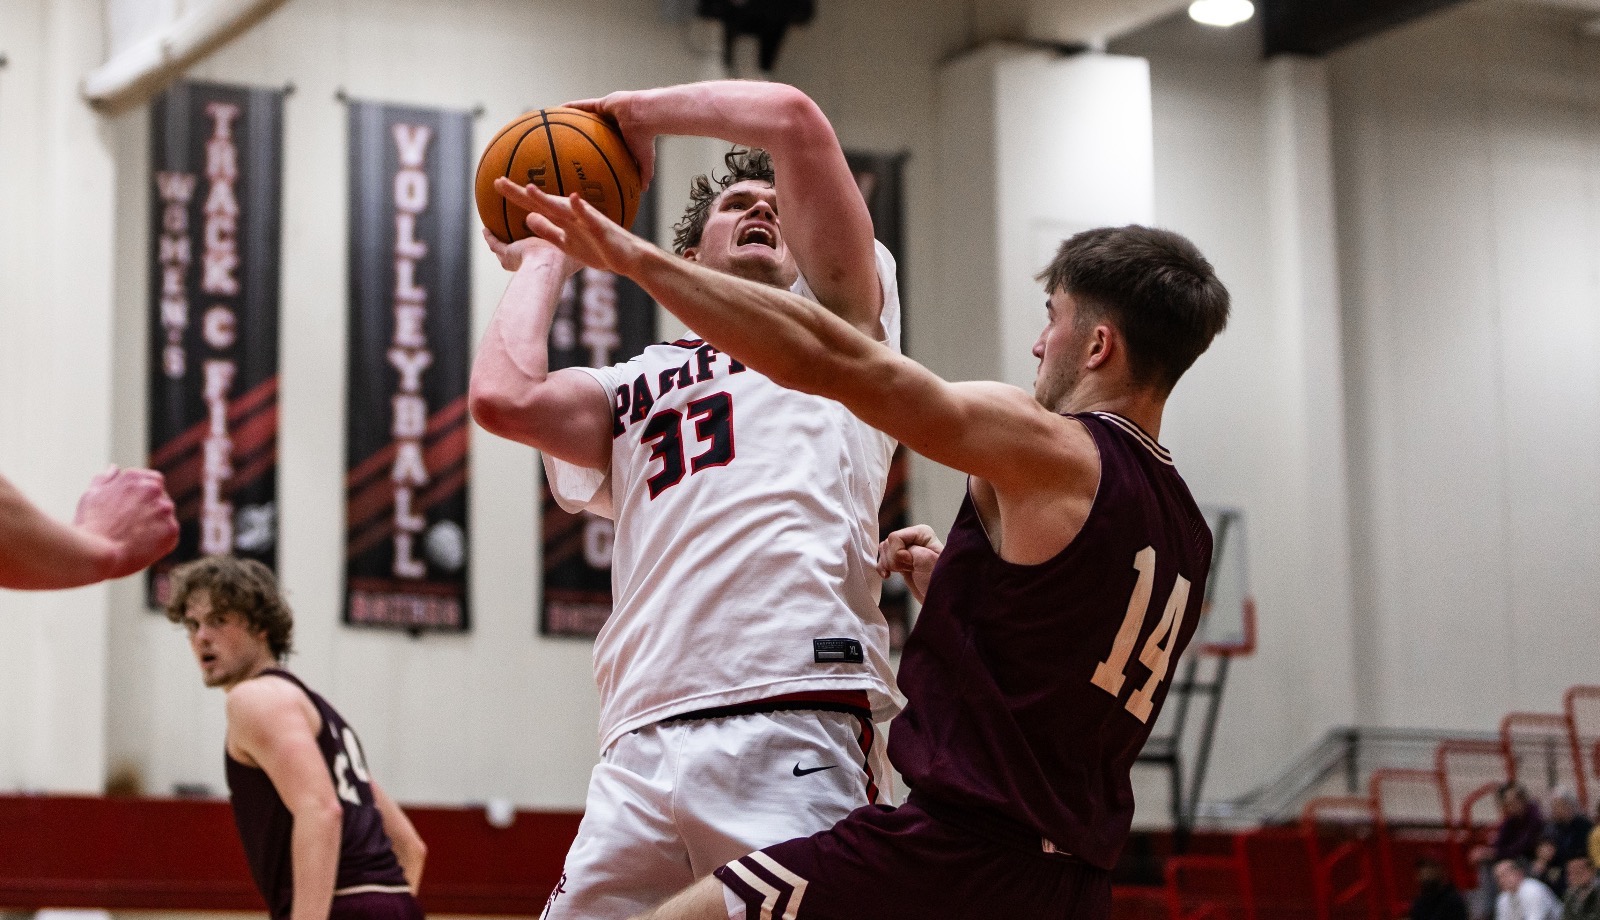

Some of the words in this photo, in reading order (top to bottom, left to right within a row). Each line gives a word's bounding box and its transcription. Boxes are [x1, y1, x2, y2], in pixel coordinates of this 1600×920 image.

[205, 102, 241, 295] TRACK
[571, 160, 587, 181] NXT
[389, 121, 433, 579] VOLLEYBALL
[202, 359, 238, 556] FIELD
[640, 391, 736, 501] 33
[1090, 545, 1192, 725] 14
